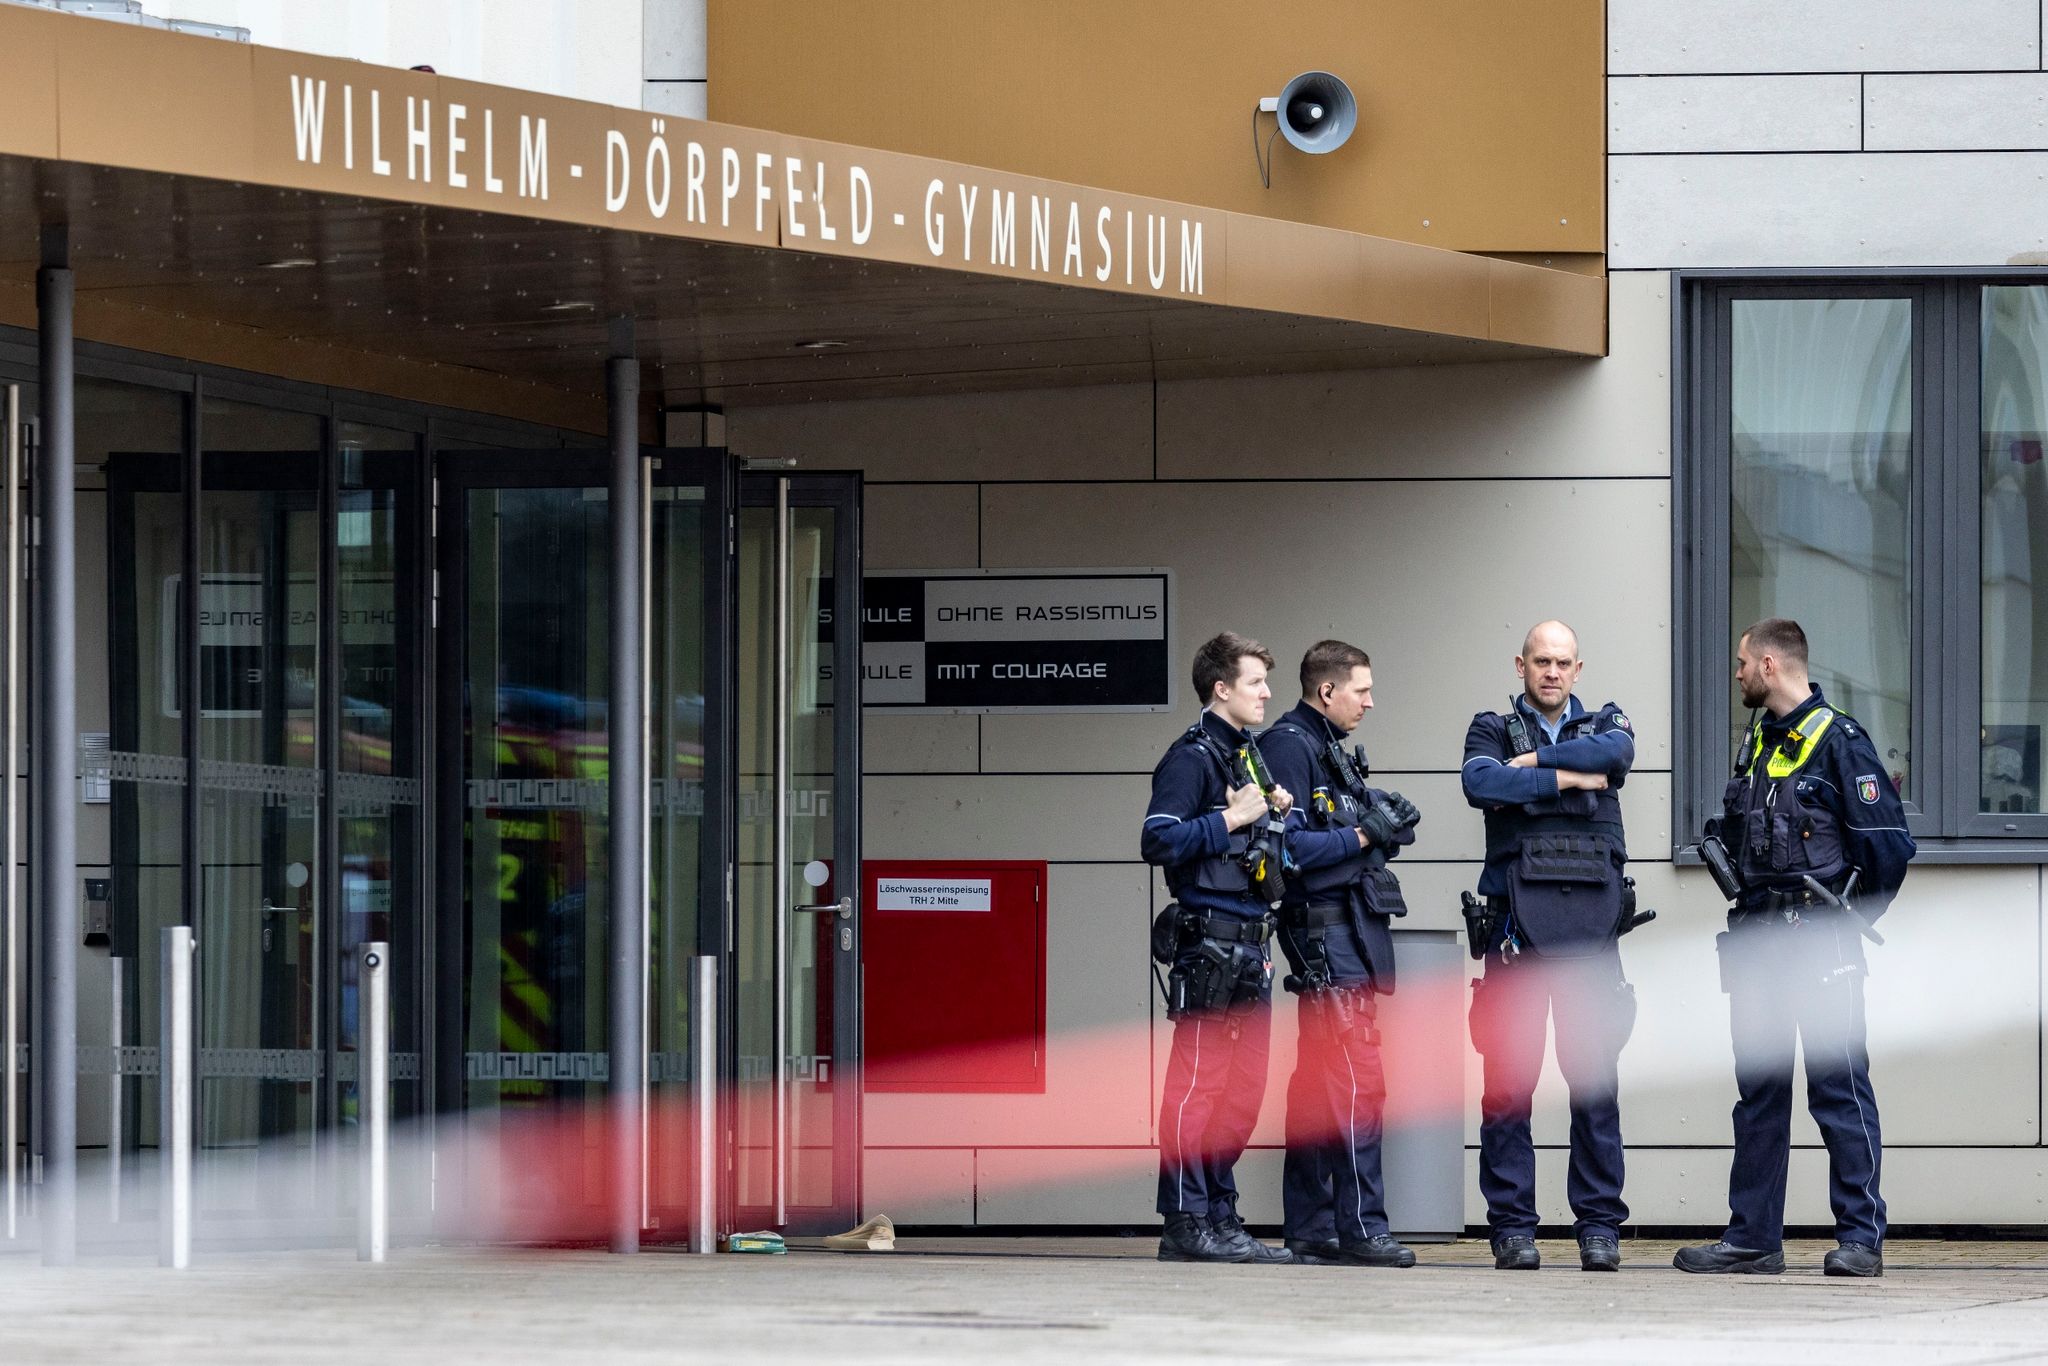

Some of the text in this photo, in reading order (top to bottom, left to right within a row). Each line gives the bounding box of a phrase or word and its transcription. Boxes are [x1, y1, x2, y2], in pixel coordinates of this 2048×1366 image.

[819, 605, 1157, 623] SULE OHNE RASSISMUS
[819, 663, 1107, 680] SULE MIT COURAGE
[879, 884, 989, 896] Löschwassereinspeisung
[909, 897, 959, 905] TRH 2 Mitte
